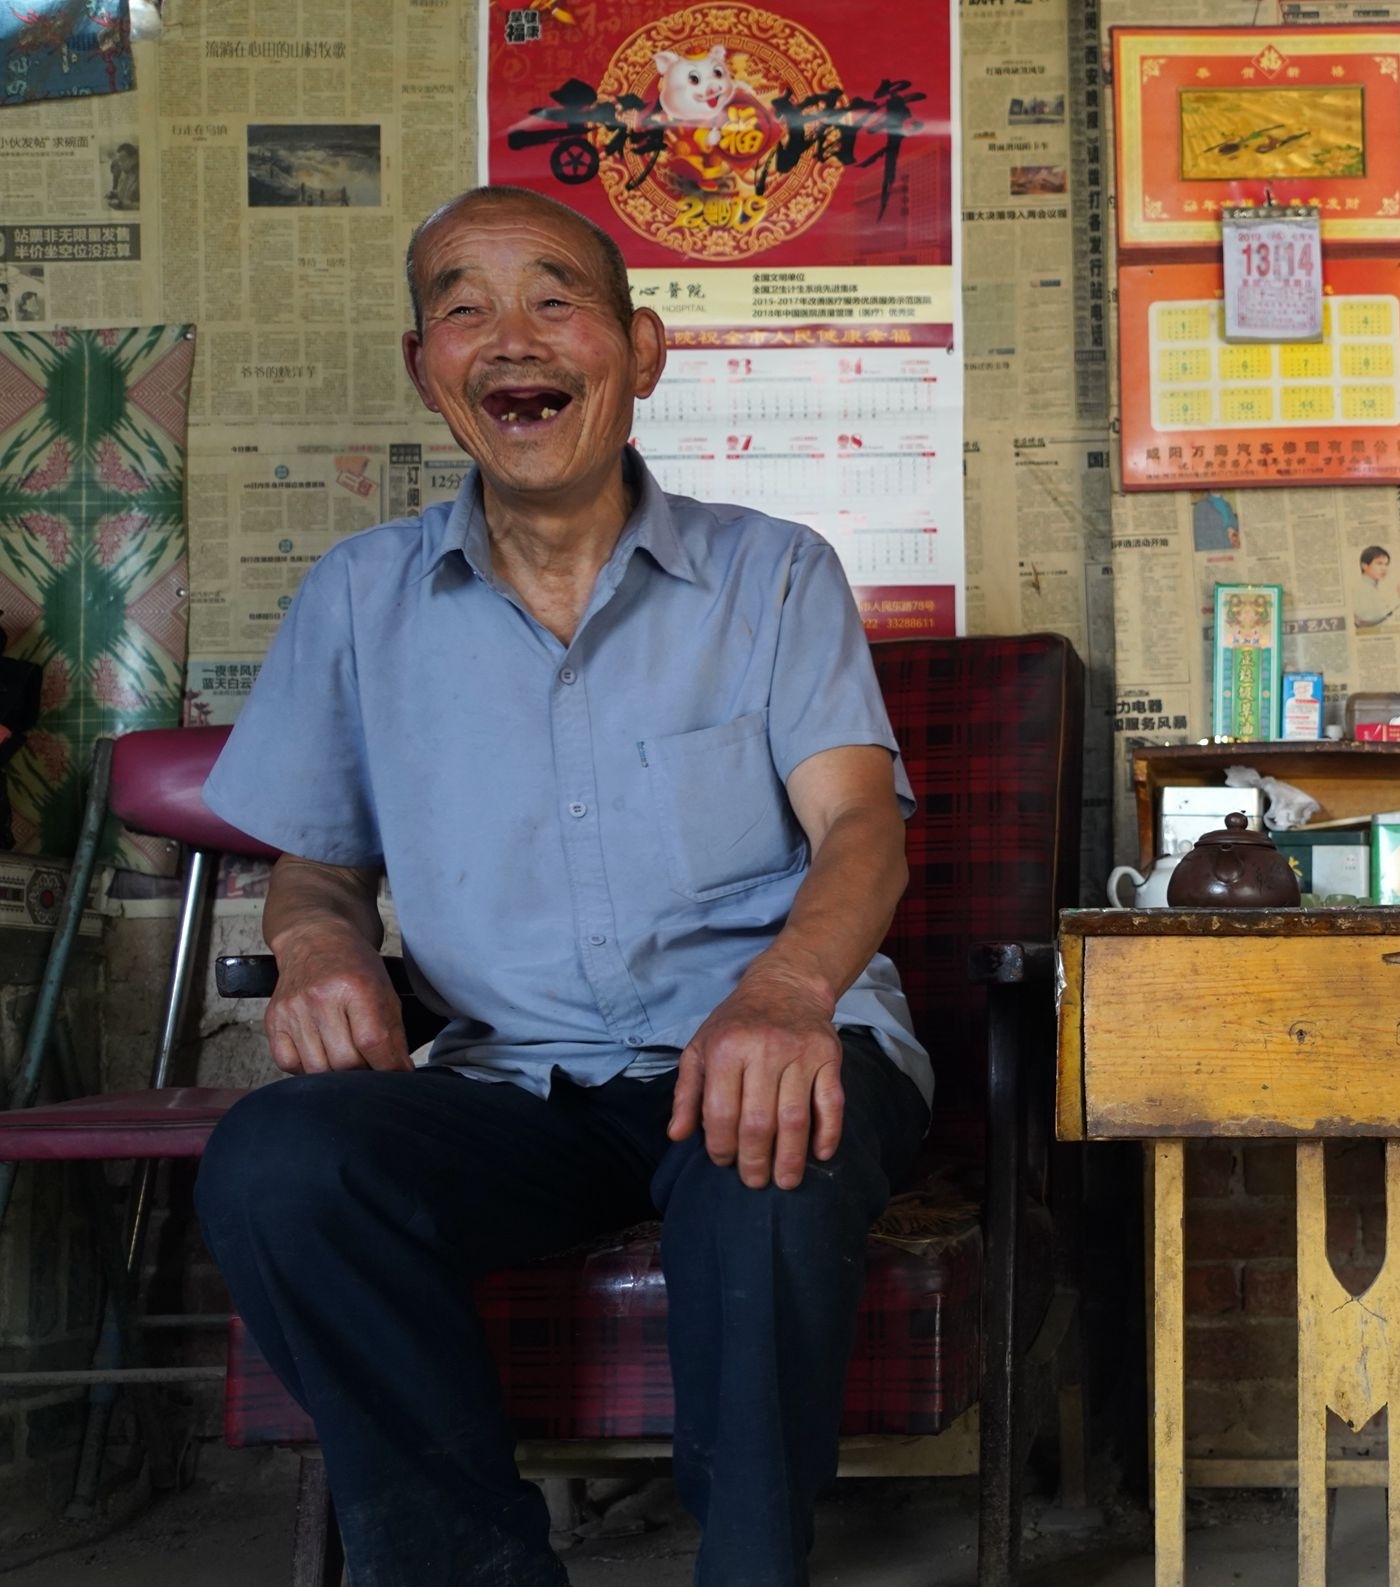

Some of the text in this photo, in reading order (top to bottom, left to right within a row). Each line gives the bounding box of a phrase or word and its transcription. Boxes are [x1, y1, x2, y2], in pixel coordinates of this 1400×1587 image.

[1259, 50, 1282, 71] 福
[720, 106, 762, 154] 福
[14, 227, 130, 242] 站票非无限量发售
[14, 244, 131, 259] 半价坐空位没法算
[1242, 244, 1270, 278] 13
[1284, 242, 1314, 277] 14
[752, 272, 805, 282] 全国文明单位
[664, 328, 912, 346] 院祝全市人民健康幸福
